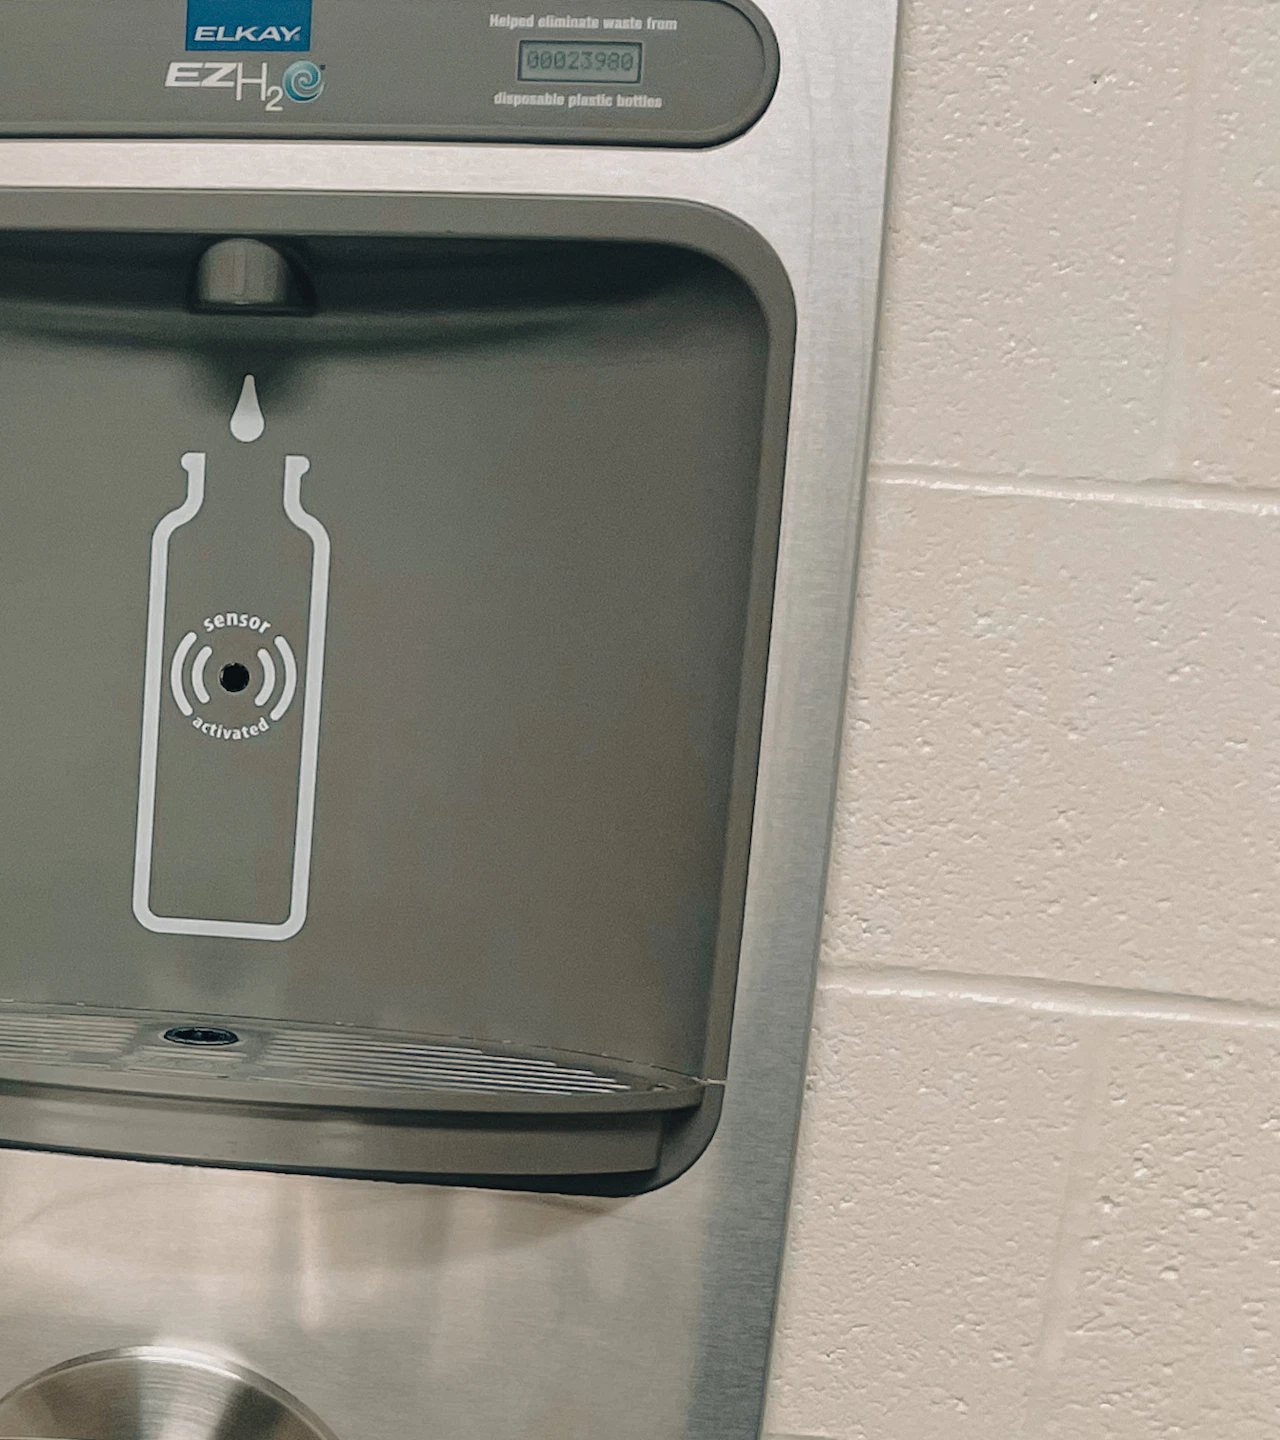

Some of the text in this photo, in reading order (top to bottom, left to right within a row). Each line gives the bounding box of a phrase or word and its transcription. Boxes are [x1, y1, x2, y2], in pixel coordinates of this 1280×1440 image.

[489, 13, 678, 31] Helped eliminate waste from
[194, 26, 301, 42] ELKAY
[494, 91, 663, 109] disposable plastic bottles
[203, 612, 271, 634] sensor
[192, 716, 269, 740] activated
